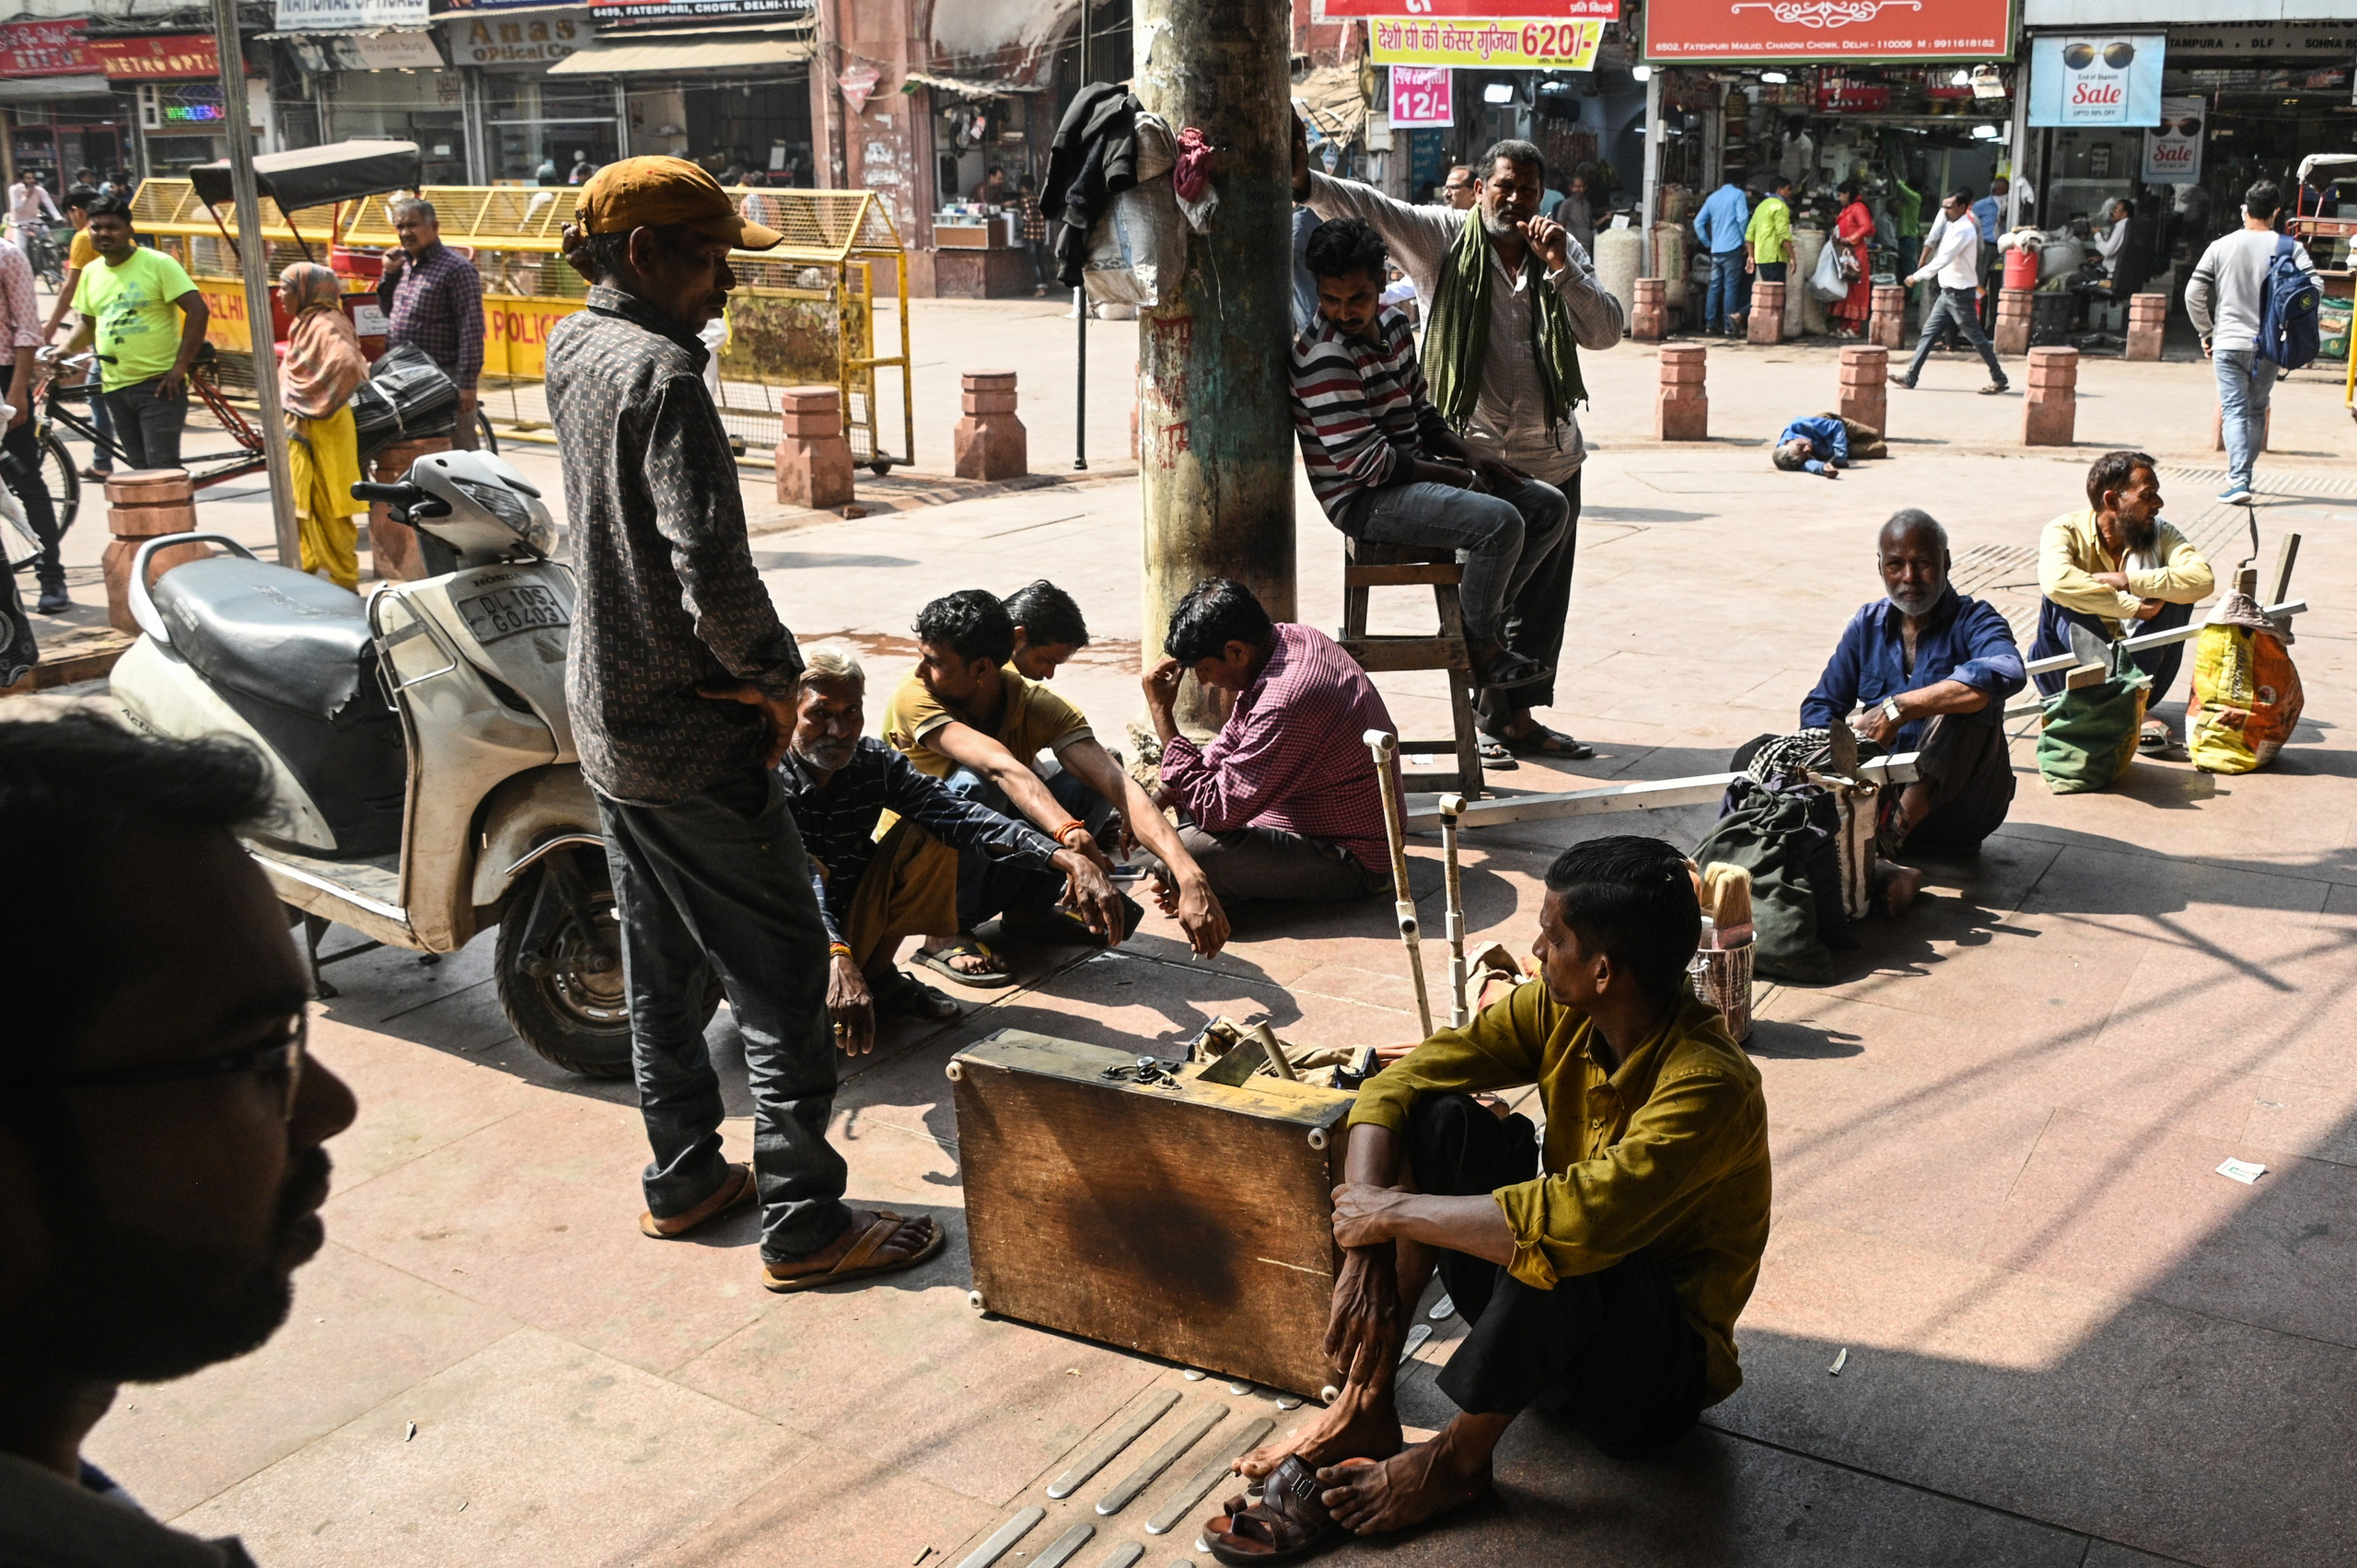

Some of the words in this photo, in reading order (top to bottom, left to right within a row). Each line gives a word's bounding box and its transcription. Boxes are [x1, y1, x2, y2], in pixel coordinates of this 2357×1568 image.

[626, 4, 692, 16] FATEHPURI,
[694, 2, 741, 13] CHOWK,
[469, 18, 577, 44] Anas
[1378, 22, 1401, 50] देशी
[1405, 22, 1419, 50] घी
[1422, 22, 1439, 51] की
[1442, 23, 1475, 51] केसर
[1477, 23, 1518, 60] गुजिया
[1522, 23, 1592, 57] 620/-
[1765, 41, 1804, 50] CHANDNI
[1842, 40, 1868, 49] DELHI
[1877, 40, 1912, 49] 110006
[1933, 39, 1995, 48] 9911618182
[2169, 39, 2223, 48] TAMPURA
[2251, 39, 2274, 48] DLF
[2305, 39, 2342, 48] SOHNA
[168, 53, 221, 72] OPTI
[2073, 83, 2121, 104] Sale
[1397, 92, 1447, 119] 12/-
[2154, 145, 2193, 161] Sale
[493, 310, 565, 343] POLIC
[473, 573, 523, 587] HONDA
